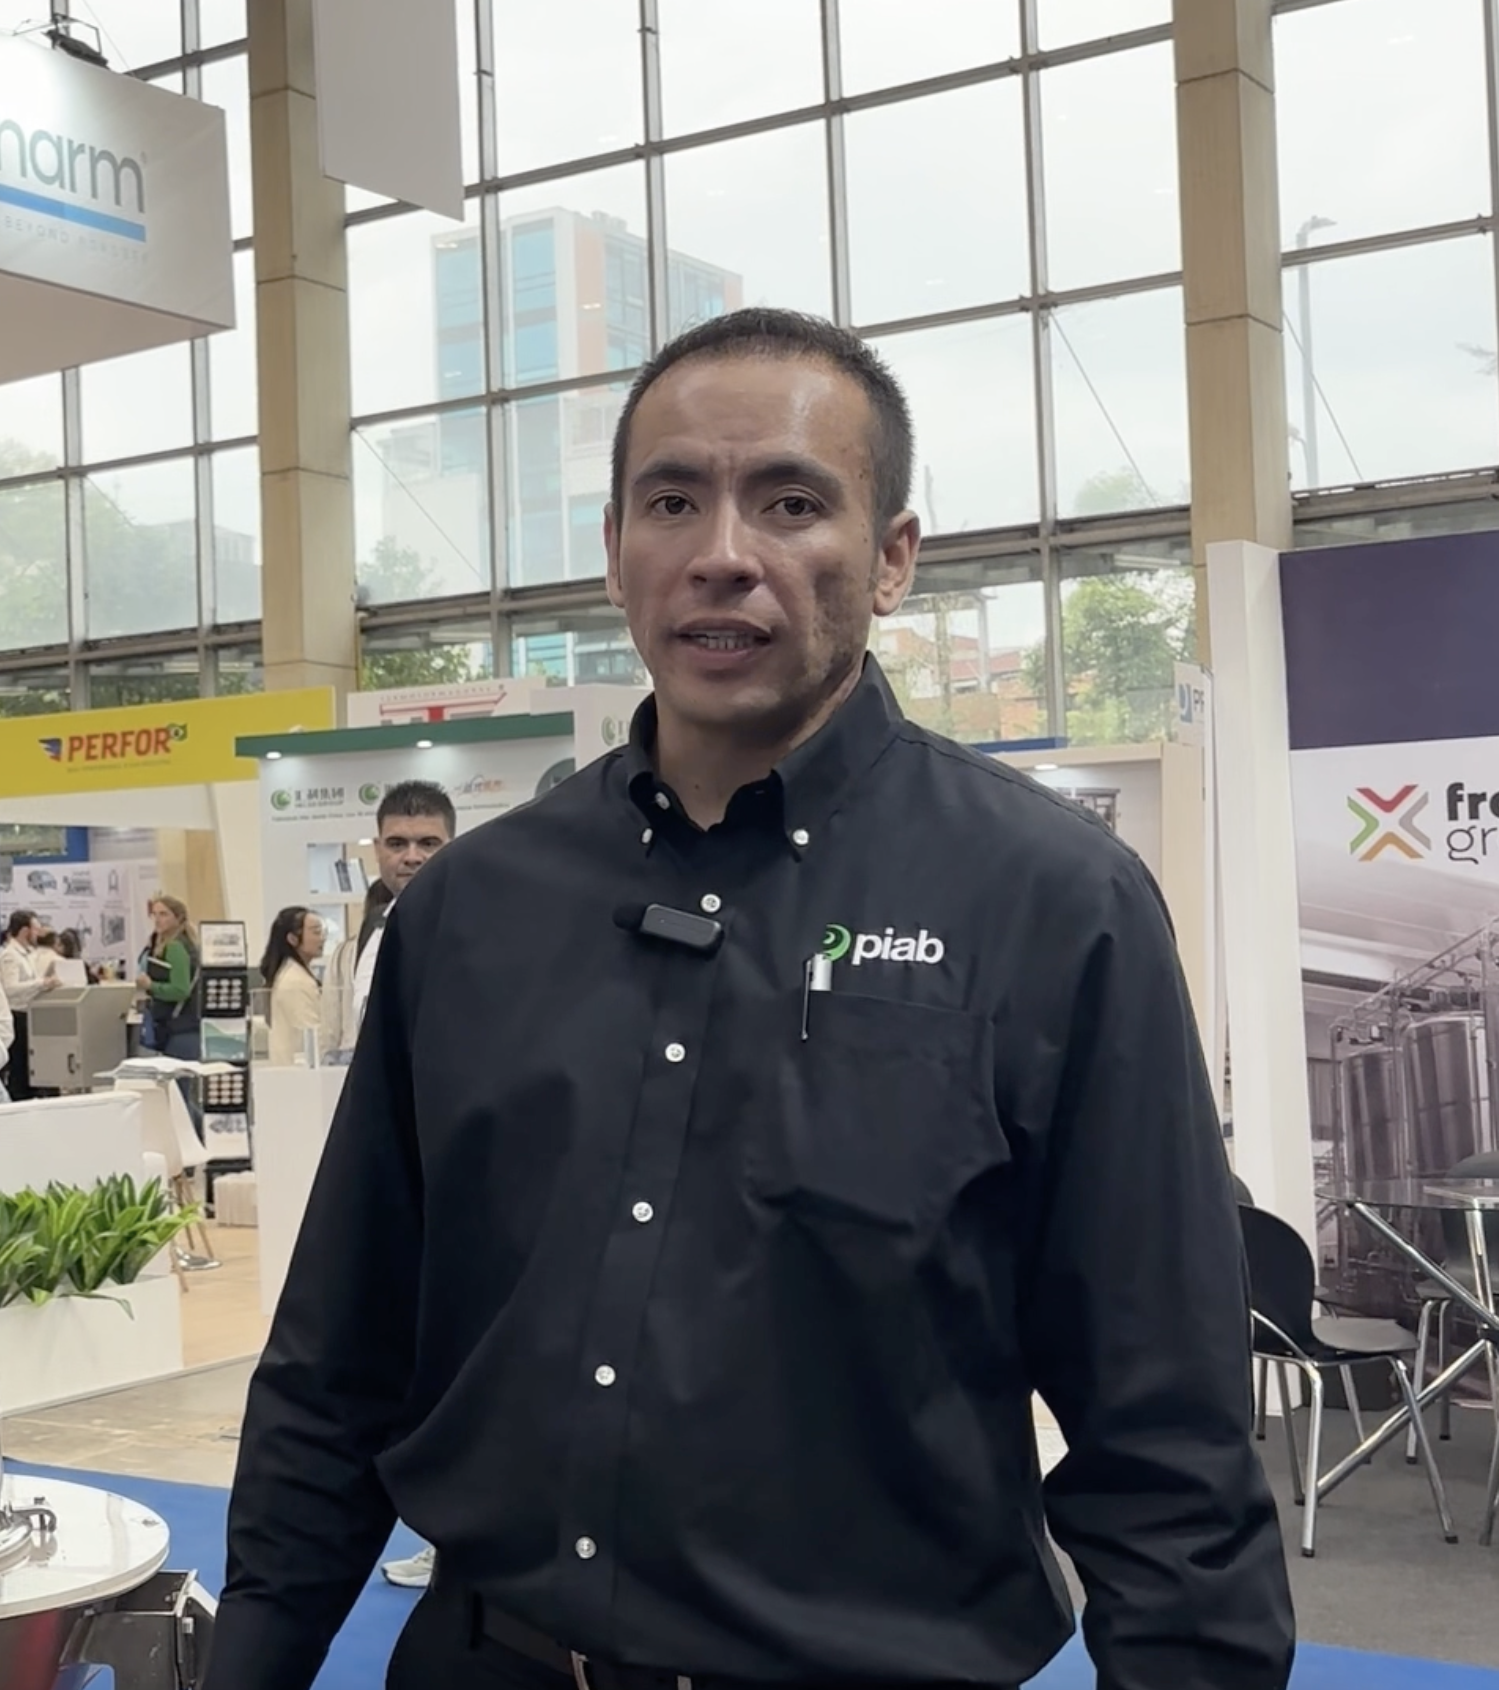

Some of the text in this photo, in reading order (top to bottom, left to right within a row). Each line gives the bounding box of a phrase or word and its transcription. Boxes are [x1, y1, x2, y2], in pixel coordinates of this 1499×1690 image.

[4, 215, 70, 244] BEYOND
[67, 726, 171, 763] PERFOR
[851, 926, 945, 966] piab
